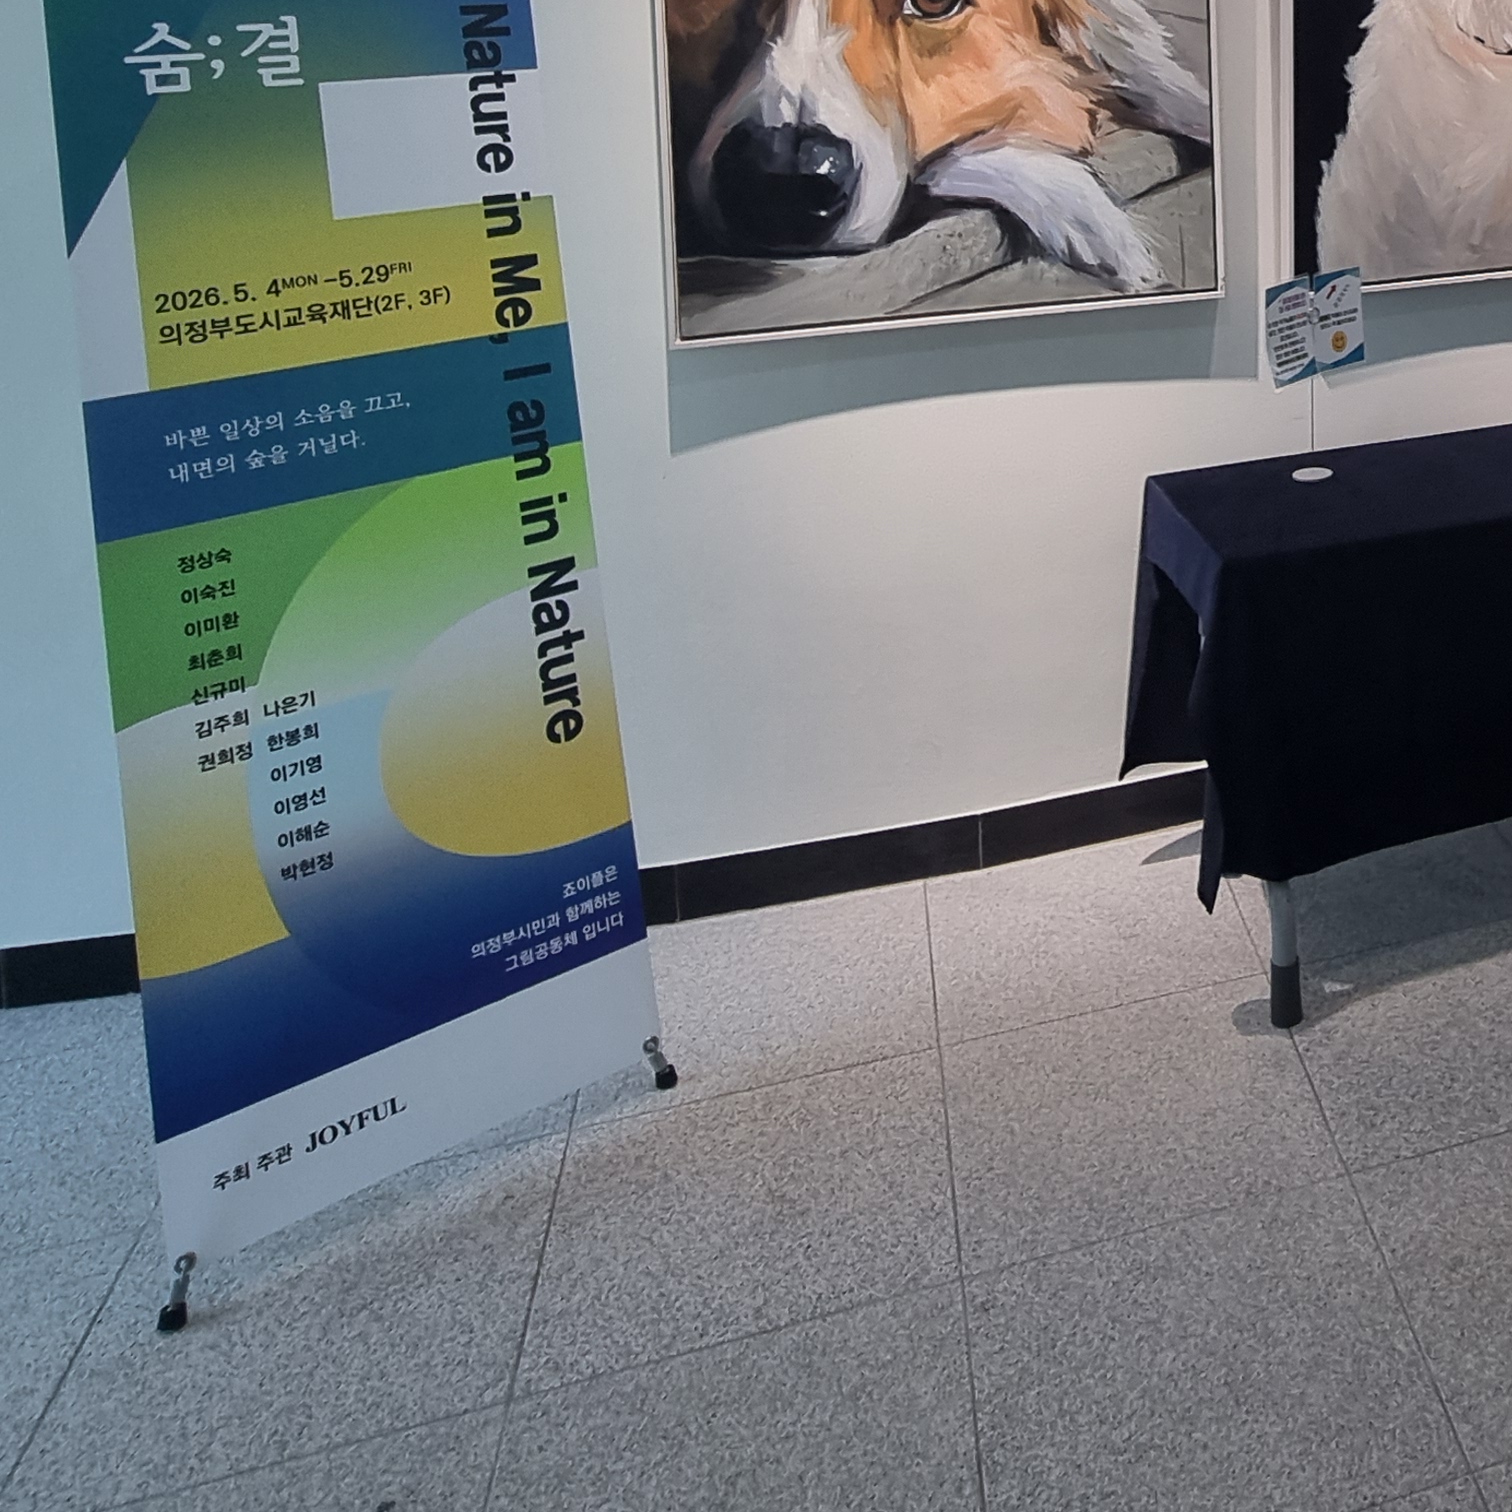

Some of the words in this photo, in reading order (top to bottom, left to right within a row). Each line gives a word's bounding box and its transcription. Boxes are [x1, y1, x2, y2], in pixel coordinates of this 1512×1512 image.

[459, 3, 517, 174] Nature
[482, 191, 531, 238] in
[488, 253, 542, 345] Me,
[158, 292, 413, 347] 의정부도시교육재단(2F,
[419, 284, 452, 307] 3F)
[503, 362, 552, 382] I
[164, 424, 210, 451] 바쁜
[219, 410, 285, 441] 일상의
[294, 398, 357, 428] 소음을
[364, 391, 411, 415] 끄고,
[168, 452, 236, 484] 내면의
[245, 443, 289, 470] 숲을
[298, 428, 367, 459] 거닐다.
[506, 399, 552, 482] am
[519, 492, 568, 546] in
[176, 547, 232, 574] 정상숙
[180, 578, 236, 605] 이숙진
[183, 610, 240, 638] 이미환
[187, 642, 243, 672] 최춘희
[527, 555, 585, 744] Nature
[191, 675, 247, 707] 신규미
[263, 689, 317, 718] 나은기
[194, 708, 250, 740] 김주희
[266, 722, 320, 753] 한봉희
[197, 741, 254, 773] 권희정
[270, 754, 323, 783] 이기영
[273, 786, 327, 816] 이영선
[277, 819, 330, 849] 이해순
[280, 850, 334, 882] 박현정
[470, 911, 562, 959] 의정부시민과
[565, 890, 622, 924] 함께하는
[504, 930, 579, 973] 그림공동체
[582, 911, 625, 941] 입니다
[212, 1160, 251, 1191] 주최
[256, 1142, 293, 1173] 주관
[304, 1095, 408, 1154] JOYFUL
